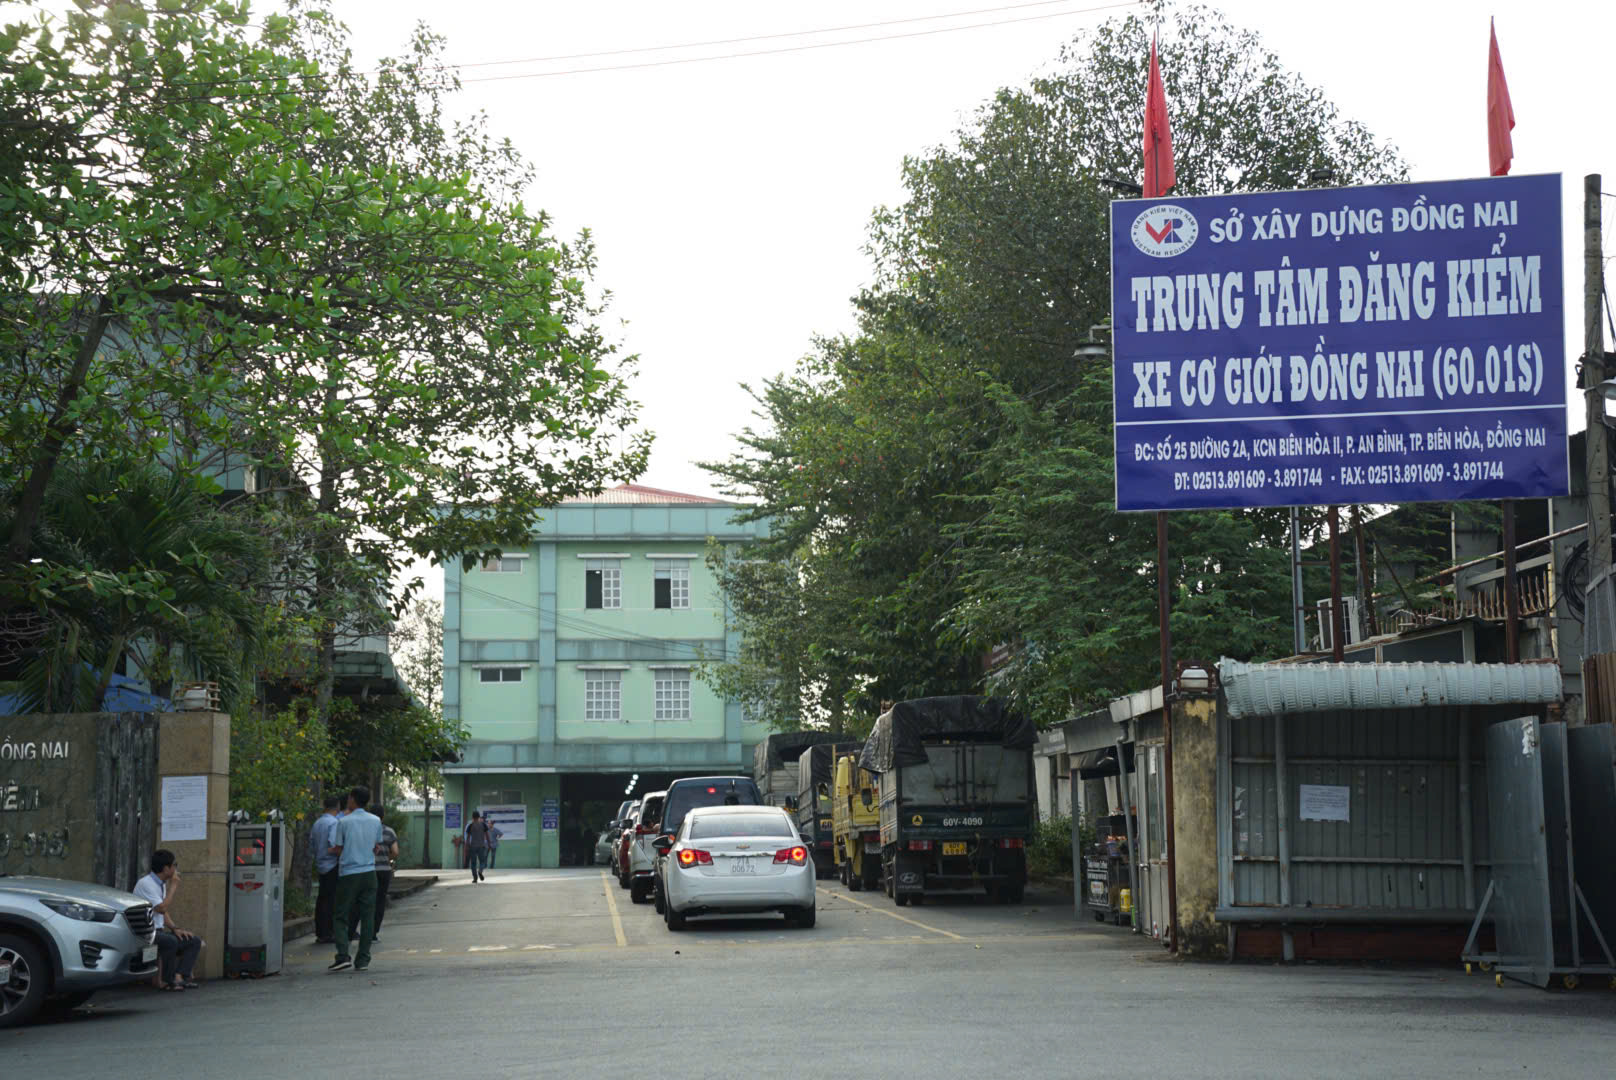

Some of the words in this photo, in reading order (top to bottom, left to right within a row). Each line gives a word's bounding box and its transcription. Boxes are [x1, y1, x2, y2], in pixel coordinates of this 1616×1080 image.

[1210, 208, 1244, 243] SỞ
[1252, 208, 1302, 240] XÂY
[1311, 206, 1383, 242] DỰNG
[1391, 195, 1464, 232] ĐỒNG
[1474, 200, 1518, 228] NAI
[1131, 272, 1244, 332] TRUNG
[1254, 256, 1329, 326] TÂM
[1339, 250, 1436, 322] ĐĂNG
[1446, 232, 1542, 318] KIỂM
[1133, 361, 1172, 408] XE
[1180, 356, 1216, 406] CƠ
[1224, 345, 1282, 405] GIỚI
[1290, 336, 1368, 402] ĐỒNG
[1376, 350, 1424, 398] NAI
[1432, 342, 1543, 400] (60.01S)
[1135, 443, 1154, 461] ĐC:
[1157, 434, 1172, 460] SỐ
[1174, 442, 1187, 460] 25
[1190, 436, 1230, 459] ĐƯỜNG
[1232, 440, 1250, 460] 2A,
[1254, 438, 1276, 457] KCN
[1280, 433, 1302, 456] BIÊN
[1306, 432, 1330, 456] HÒA
[1333, 436, 1344, 458] II,
[1346, 436, 1354, 454] P.
[1358, 434, 1374, 454] AN
[1377, 428, 1407, 455] BÌNH,
[1410, 433, 1424, 451] TP.
[1428, 427, 1450, 450] BIÊN
[1454, 426, 1484, 452] HÒA,
[1487, 420, 1522, 448] ĐỒNG
[1526, 428, 1546, 446] NAI
[1174, 472, 1190, 490] ĐT:
[1192, 470, 1266, 490] 02513.891609
[1274, 468, 1322, 488] 3.891744
[1341, 466, 1365, 485] FAX:
[1368, 464, 1444, 484] 02513.891609
[1453, 461, 1504, 481] 3.891744
[41, 741, 69, 759] NAI
